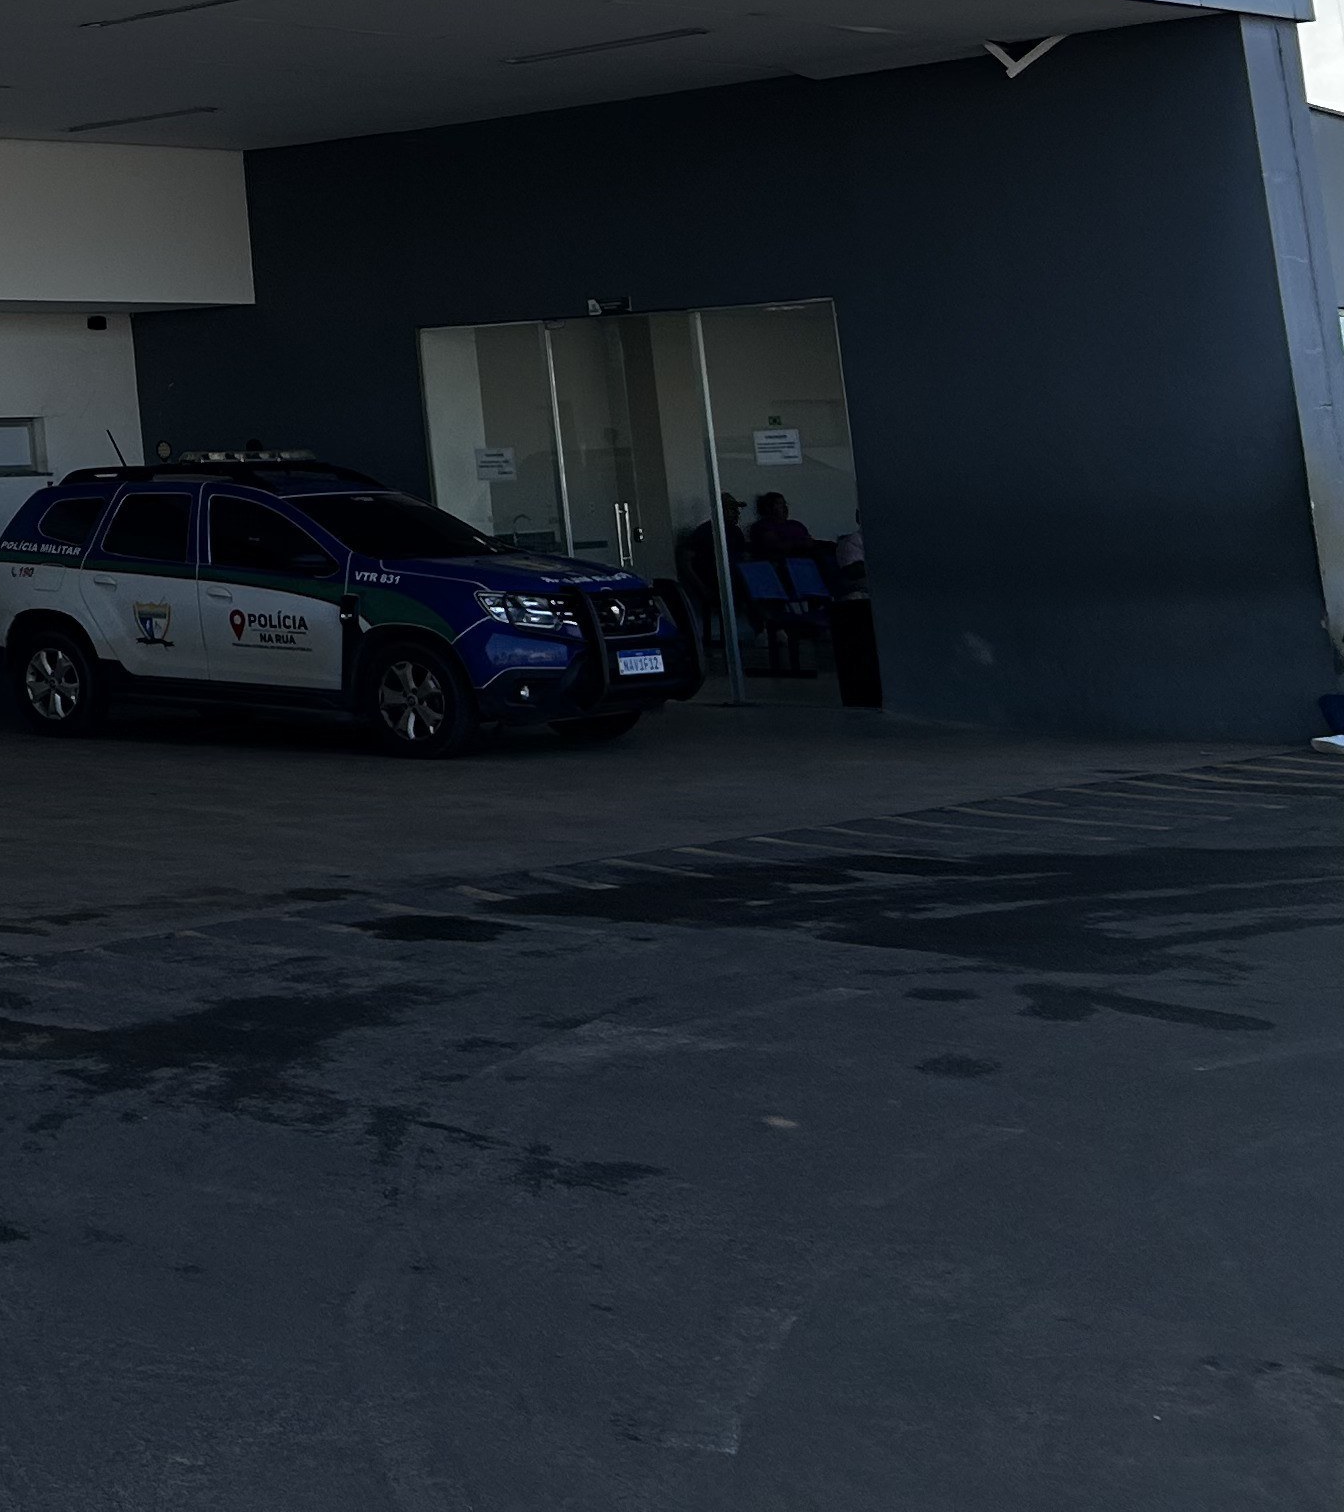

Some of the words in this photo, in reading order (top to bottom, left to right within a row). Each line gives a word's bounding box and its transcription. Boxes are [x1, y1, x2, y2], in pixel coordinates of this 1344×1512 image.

[0, 539, 38, 553] POLÍCIA
[39, 542, 82, 556] MILITAR
[354, 570, 379, 583] VTR
[247, 609, 309, 631] POLÍCIA
[259, 633, 275, 644] NA
[274, 633, 297, 645] RUA
